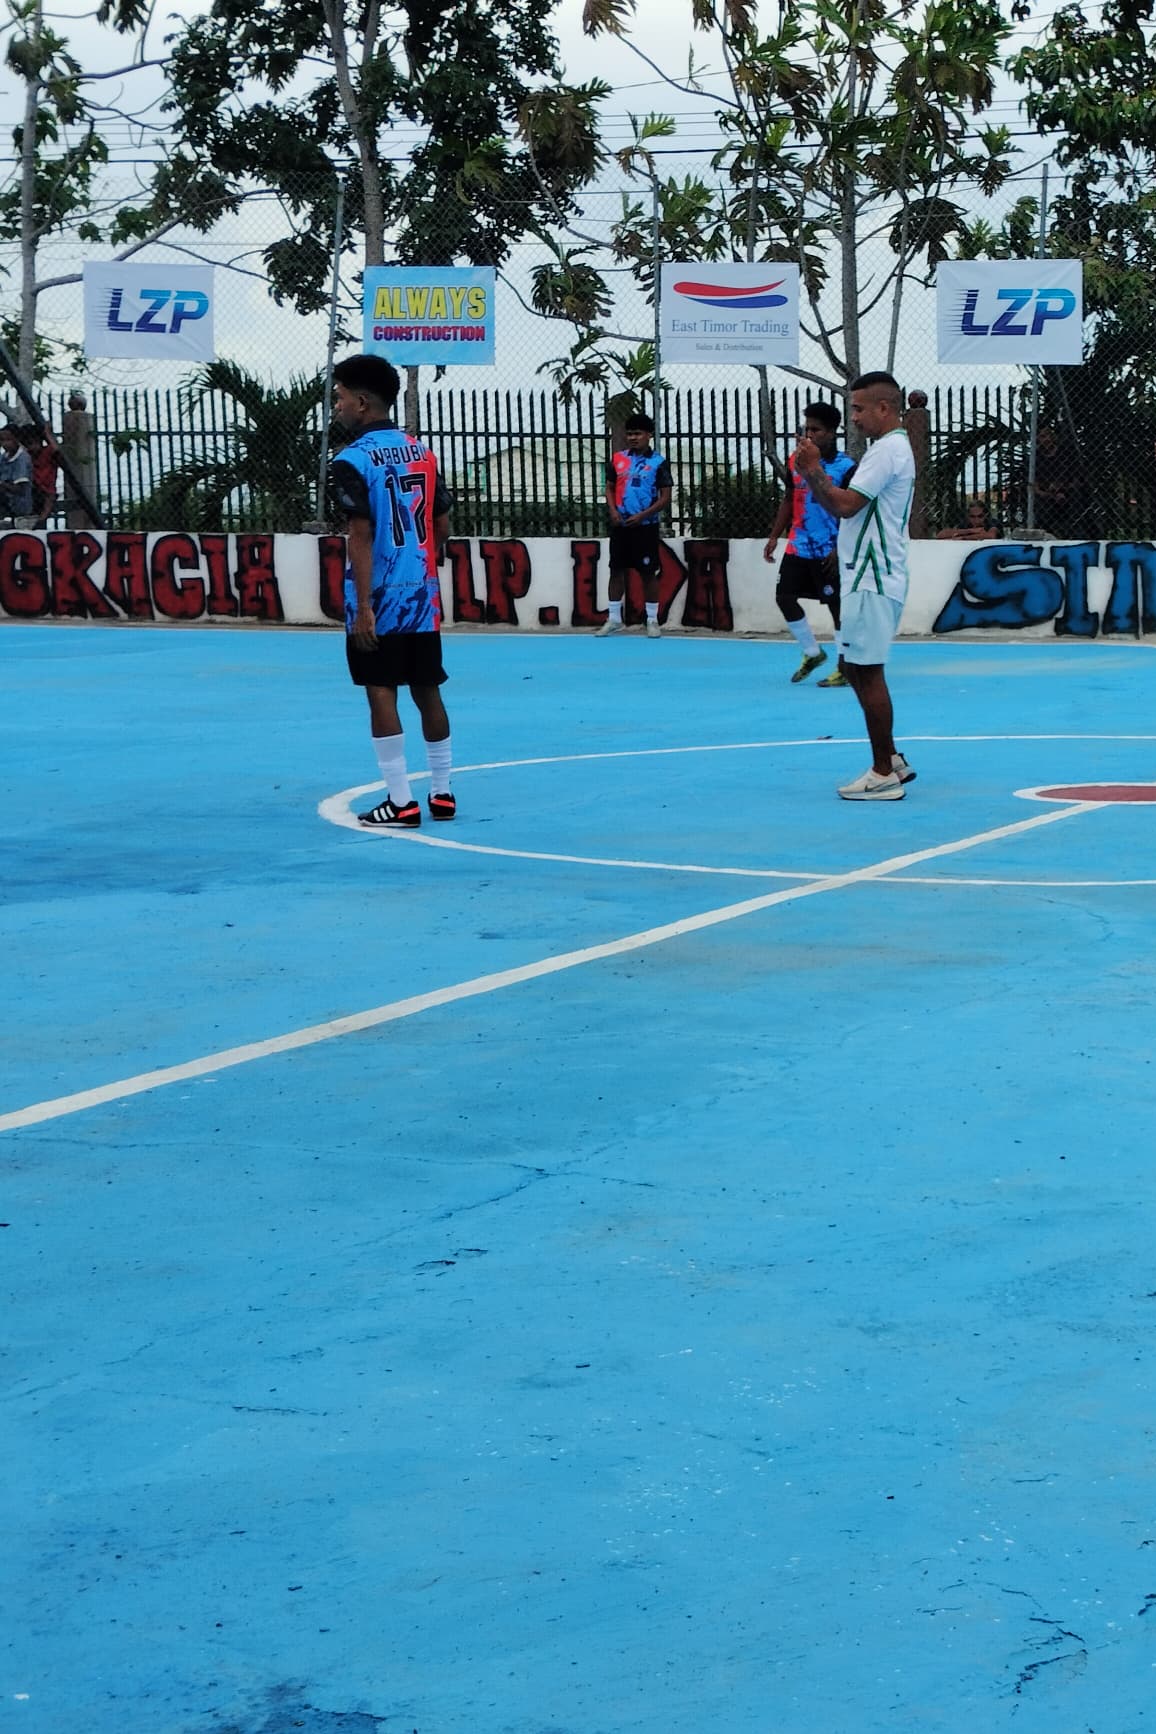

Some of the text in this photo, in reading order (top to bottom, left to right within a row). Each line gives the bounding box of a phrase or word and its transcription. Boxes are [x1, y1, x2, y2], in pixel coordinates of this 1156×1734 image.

[105, 288, 209, 333] LZP
[374, 286, 487, 319] ALWAYS
[959, 288, 1076, 336] LZP
[373, 326, 486, 341] CONSTRUCTION
[672, 319, 789, 336] East Timor Trading
[385, 472, 427, 548] 17
